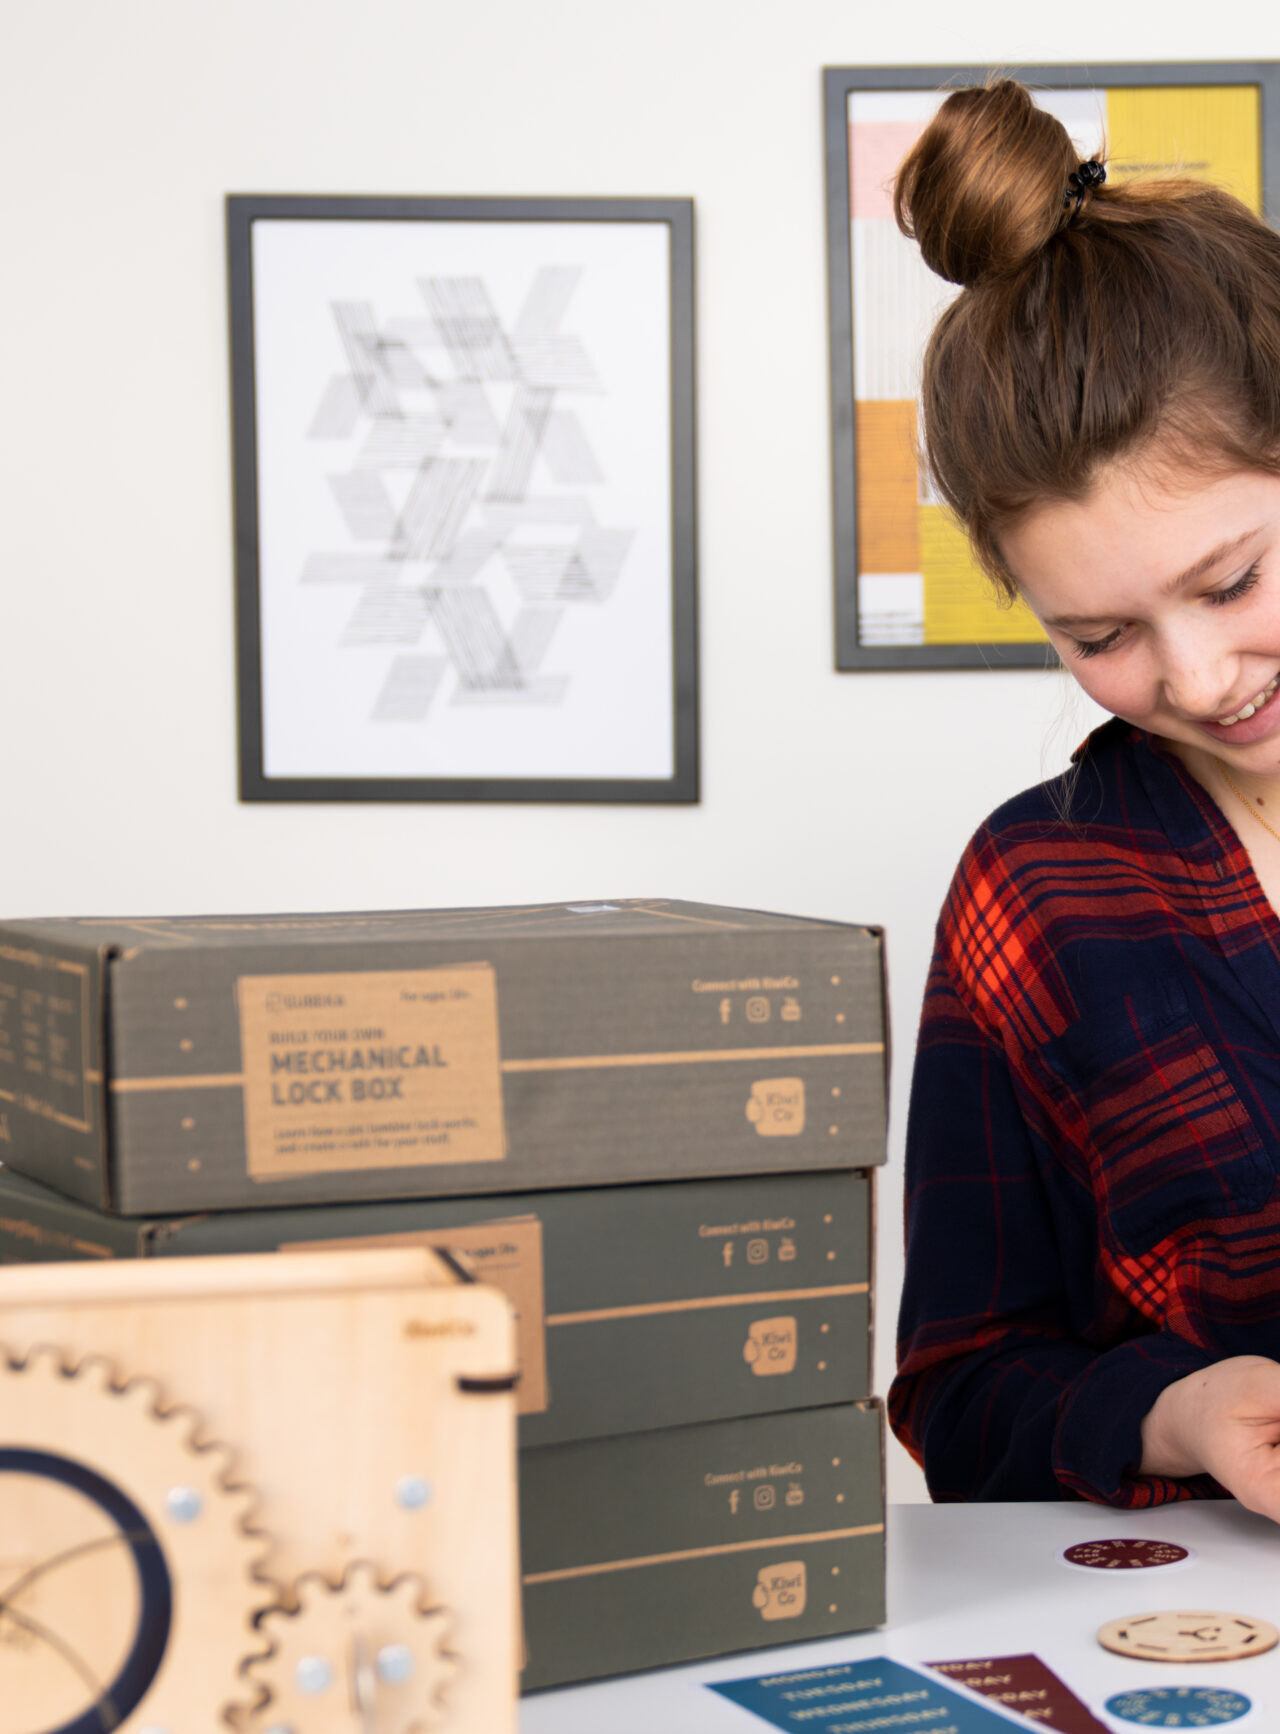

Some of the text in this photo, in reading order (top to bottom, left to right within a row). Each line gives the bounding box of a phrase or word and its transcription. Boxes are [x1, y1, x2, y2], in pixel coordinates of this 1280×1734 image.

[692, 979, 736, 993] Connect
[739, 977, 760, 991] with
[270, 1044, 447, 1076] MECHANICAL
[271, 1075, 405, 1107] LOCK BOX
[766, 1091, 798, 1122] Kiwi Co
[699, 1217, 795, 1238] Connect with KiwiCo
[762, 1330, 792, 1361] Kiwi Co
[704, 1462, 803, 1487] Connect with KiwiCo
[771, 1574, 801, 1606] Kiwi Co
[759, 1666, 852, 1688] MONDAY
[780, 1677, 883, 1702] TUESDAY
[789, 1689, 928, 1721] WEDNESDAY
[827, 1706, 947, 1734] THURSDAY
